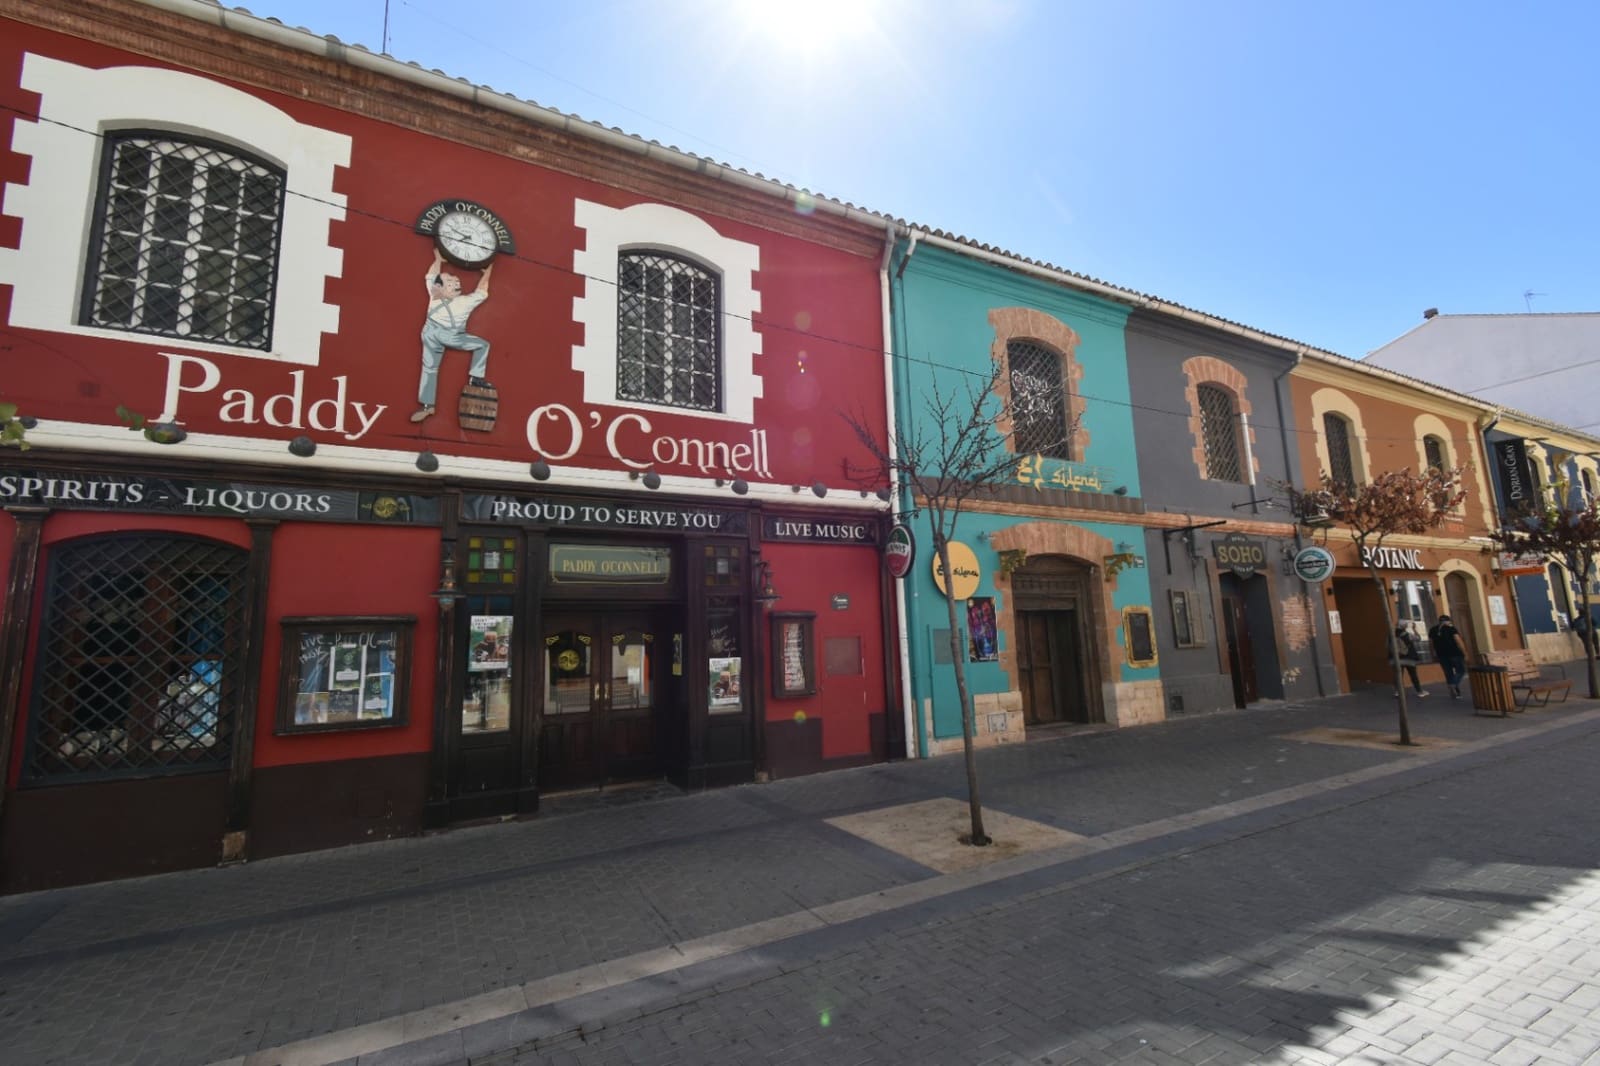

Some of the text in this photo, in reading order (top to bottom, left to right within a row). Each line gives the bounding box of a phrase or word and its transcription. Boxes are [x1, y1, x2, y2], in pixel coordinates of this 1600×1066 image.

[420, 201, 511, 246] PADDY O'CONNELL
[147, 351, 774, 479] Paddy O'Connell
[0, 476, 144, 503] SPIRITS
[183, 487, 331, 514] LIQUORS
[493, 500, 721, 528] PROUD TO SERVE YOU
[775, 522, 865, 539] LIVE MUSIC
[562, 559, 597, 573] PADDY
[1217, 546, 1263, 563] SOHO
